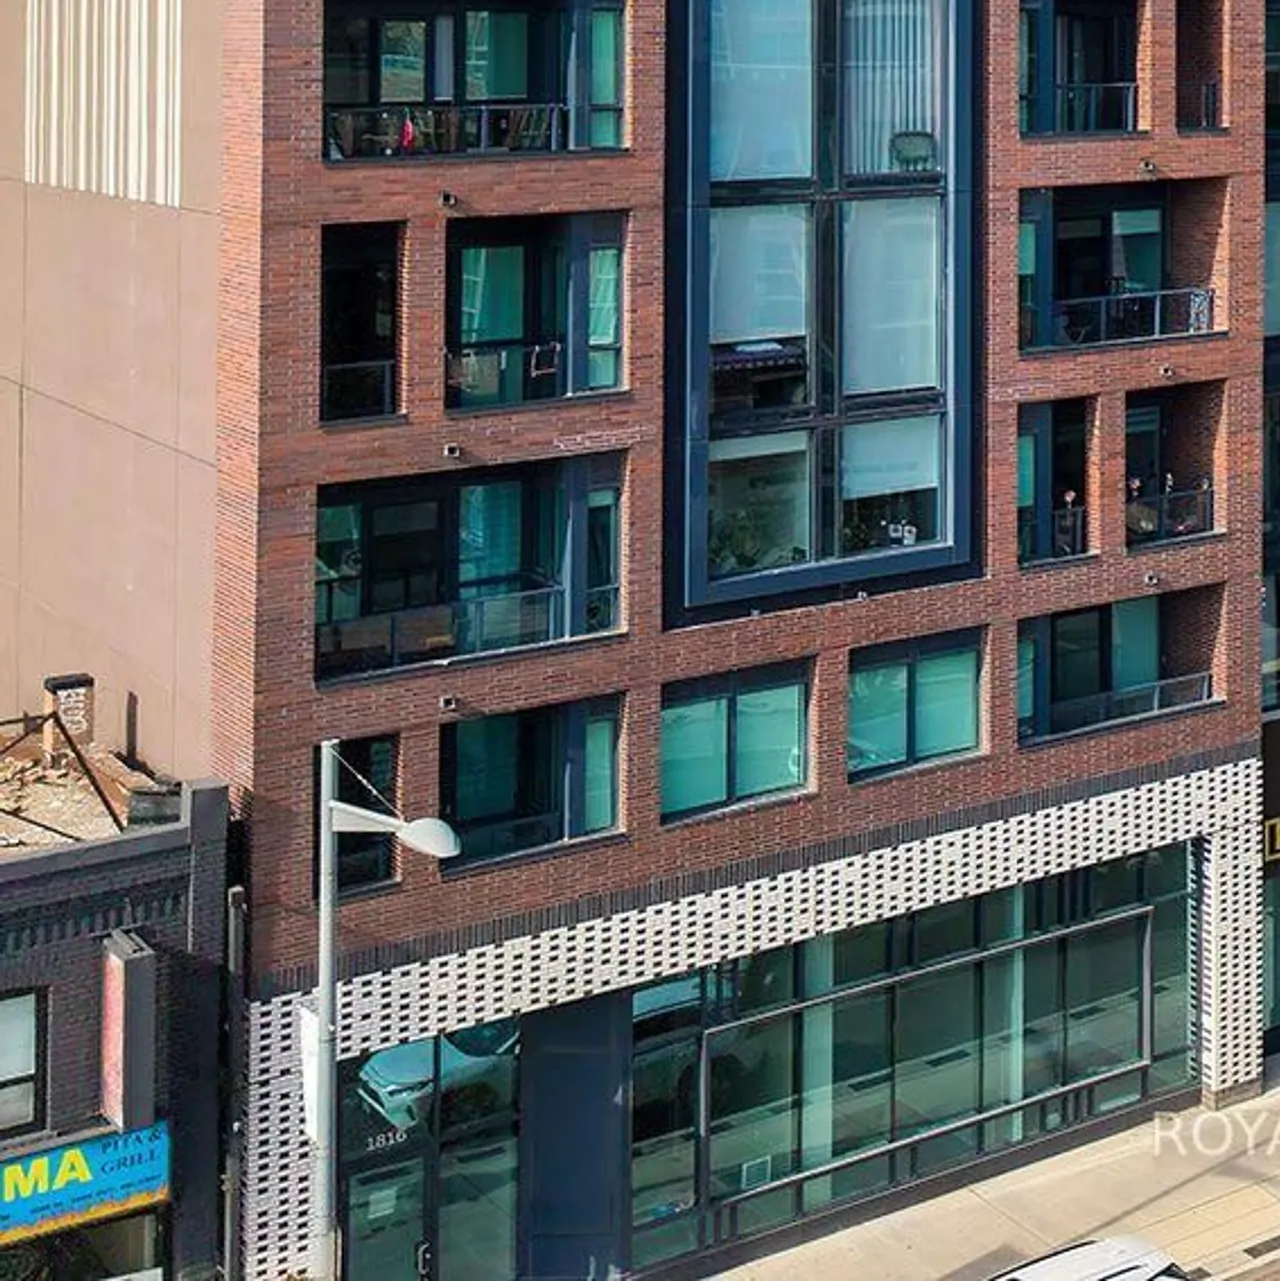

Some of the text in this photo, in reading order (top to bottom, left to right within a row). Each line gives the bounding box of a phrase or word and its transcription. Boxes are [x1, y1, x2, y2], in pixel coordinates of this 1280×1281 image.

[4, 1148, 94, 1202] MA
[101, 1132, 144, 1155] PITA
[101, 1150, 160, 1176] GRILL
